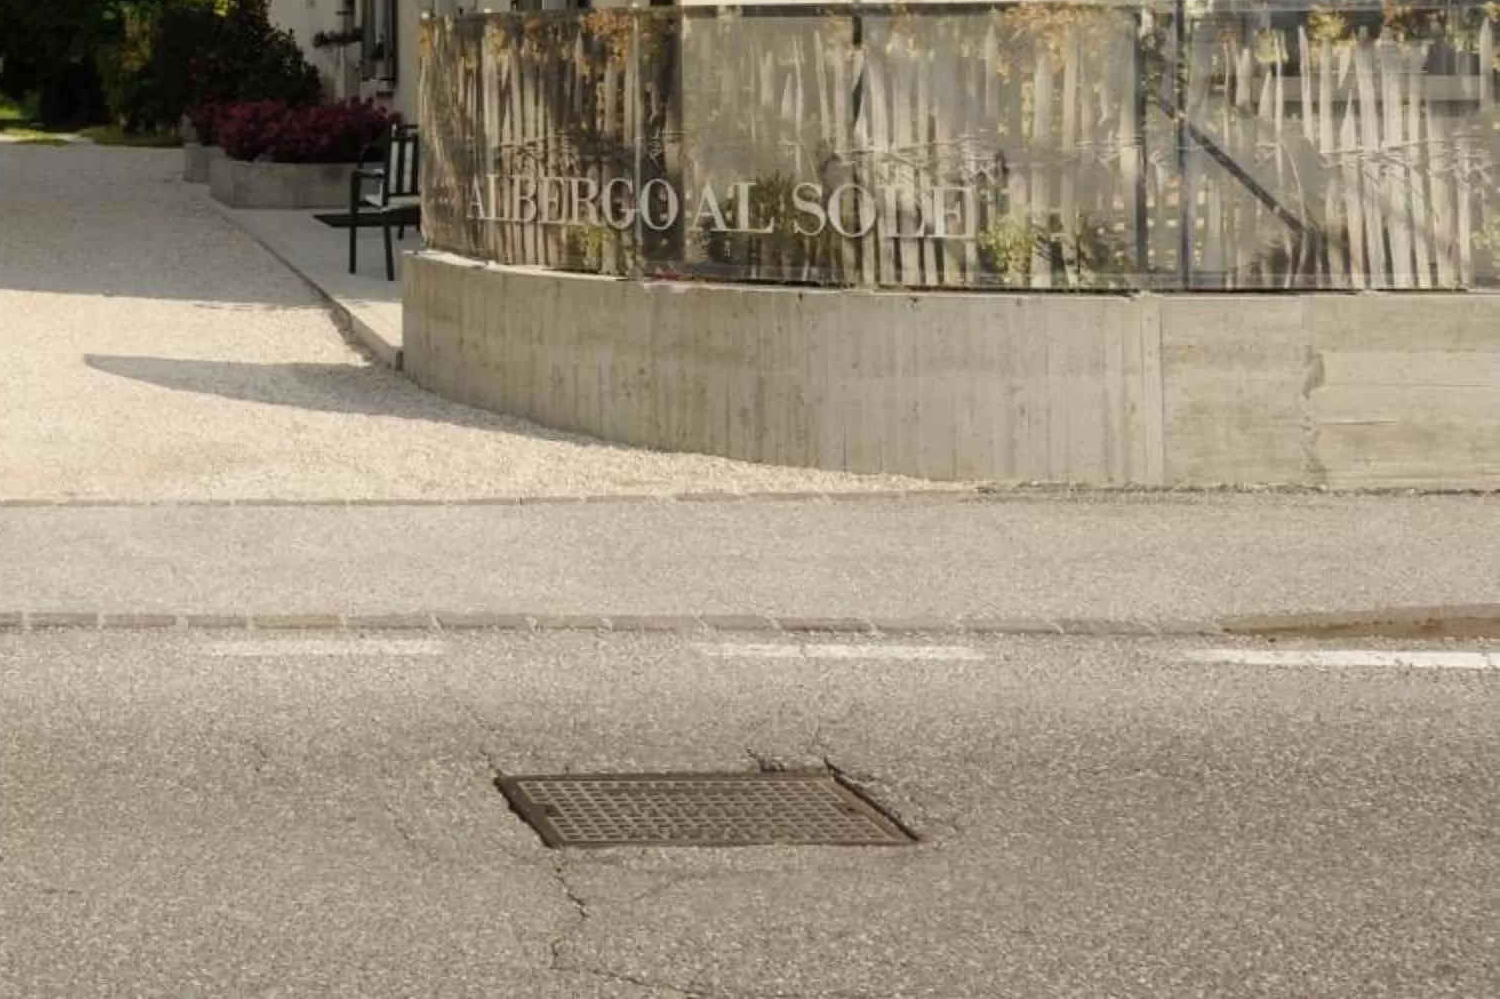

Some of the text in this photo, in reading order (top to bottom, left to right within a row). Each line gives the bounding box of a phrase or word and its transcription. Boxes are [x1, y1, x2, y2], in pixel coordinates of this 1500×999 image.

[467, 173, 977, 239] ALBERGO AL SOLE
